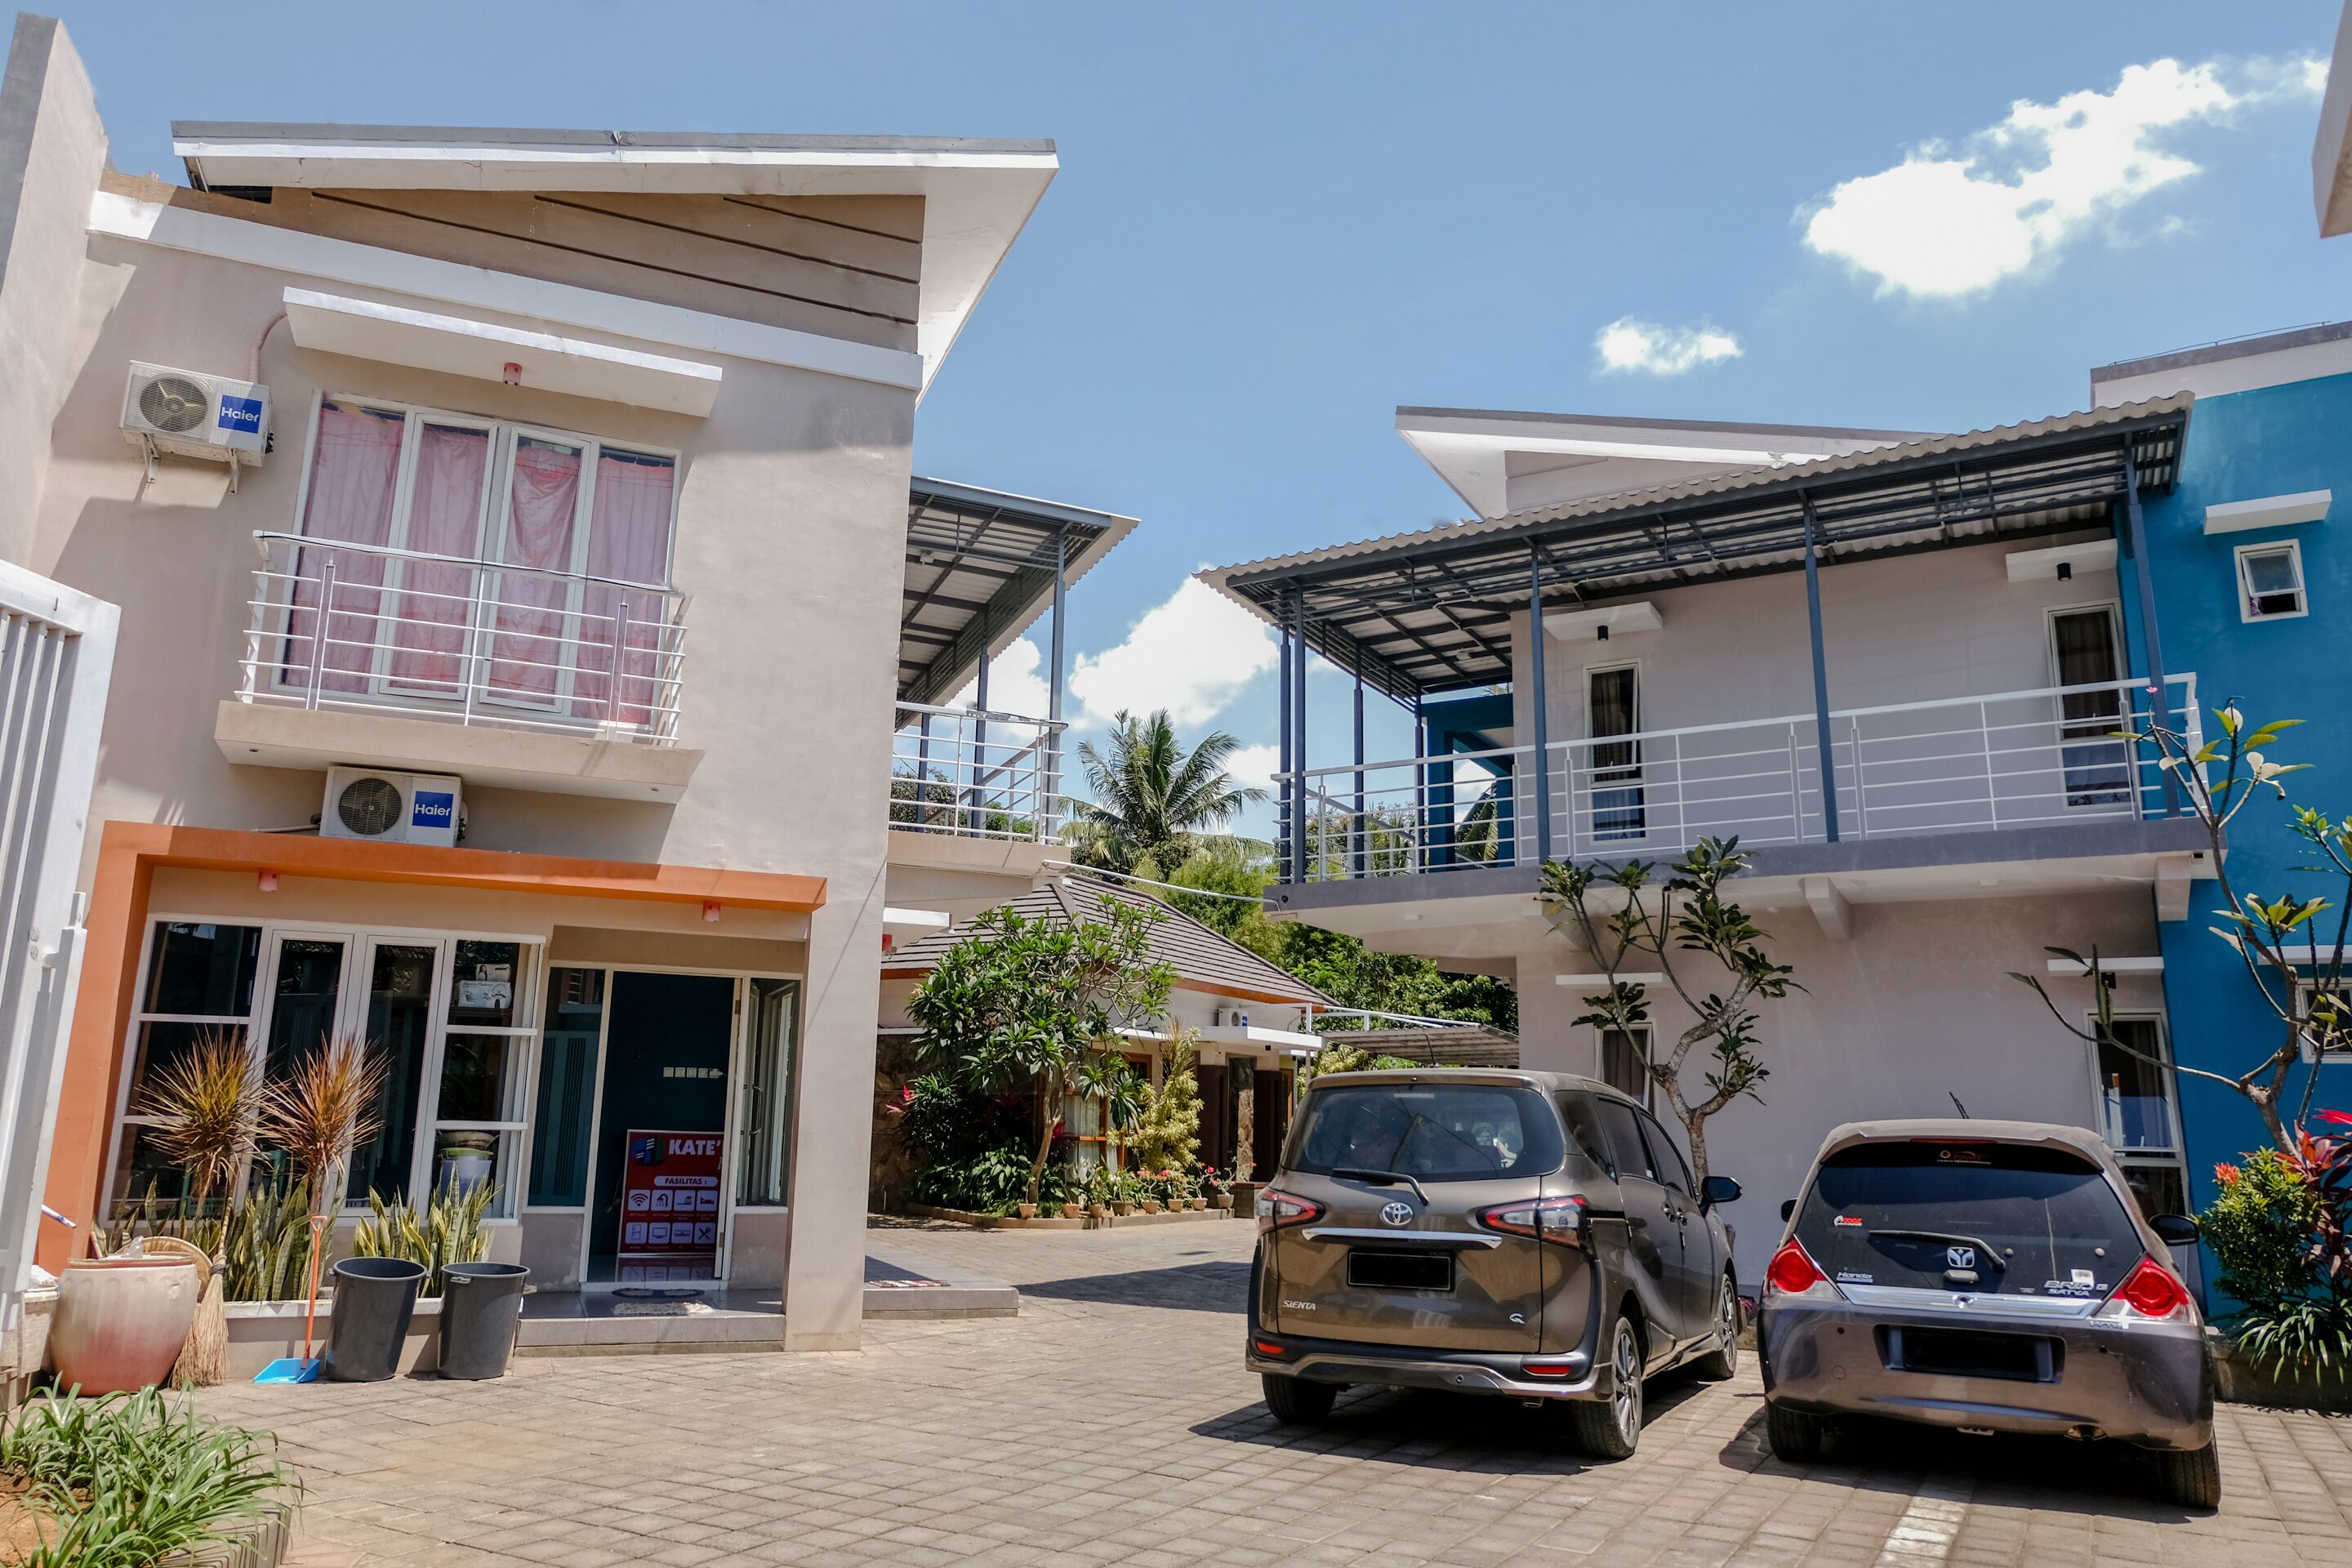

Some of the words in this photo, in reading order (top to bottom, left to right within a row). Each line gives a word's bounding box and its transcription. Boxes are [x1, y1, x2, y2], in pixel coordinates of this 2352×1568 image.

[221, 407, 259, 422] Haier
[415, 804, 451, 816] Haier
[669, 1139, 721, 1156] KATE'
[2043, 1280, 2095, 1290] BRIO
[2047, 1289, 2090, 1297] SATYA
[1282, 1299, 1316, 1311] SIENTA
